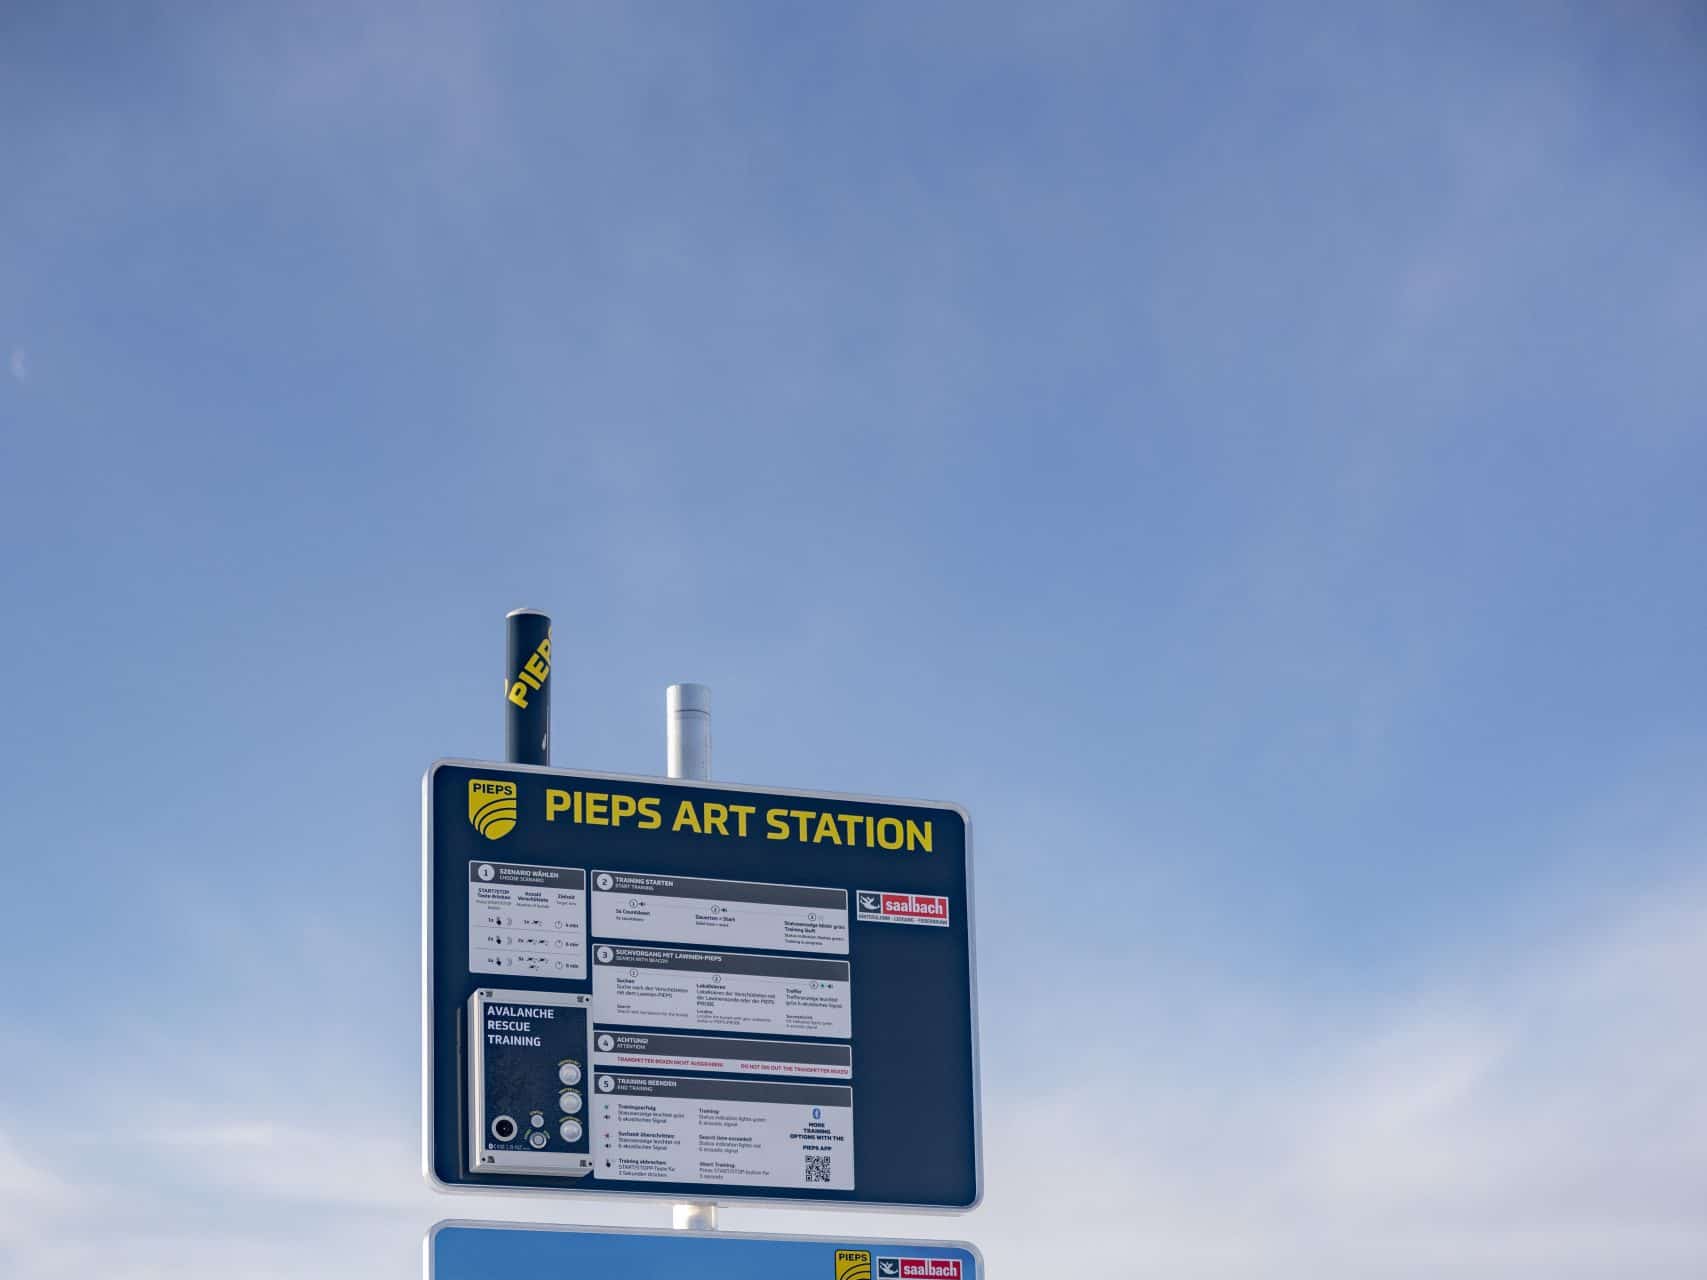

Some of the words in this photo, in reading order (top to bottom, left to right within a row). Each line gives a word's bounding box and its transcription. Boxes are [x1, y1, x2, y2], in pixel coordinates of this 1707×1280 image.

[508, 626, 551, 709] PIEP
[472, 783, 513, 796] PIEPS
[545, 788, 662, 830] PIEPS
[672, 800, 756, 838] ART
[766, 808, 933, 853] STATION
[499, 868, 531, 877] SZENARIO
[532, 871, 559, 879] WÄHLEN
[615, 876, 645, 885] TRAINING
[645, 879, 674, 887] STARTEN
[885, 895, 944, 915] saalbach
[602, 951, 608, 959] 3
[615, 949, 662, 958] SUCHVORGANG
[662, 951, 674, 959] MIT
[487, 1005, 555, 1020] AVALANCHE
[487, 1020, 531, 1032] RESCUE
[487, 1034, 542, 1047] TRAINING
[602, 1039, 609, 1047] 4
[603, 1080, 610, 1088] 5
[617, 1078, 647, 1086] TRAINING
[647, 1080, 677, 1088] BEENDEN
[789, 1133, 816, 1141] OPTIONS
[839, 1252, 869, 1262] PIEPS
[903, 1259, 957, 1277] saalbach
